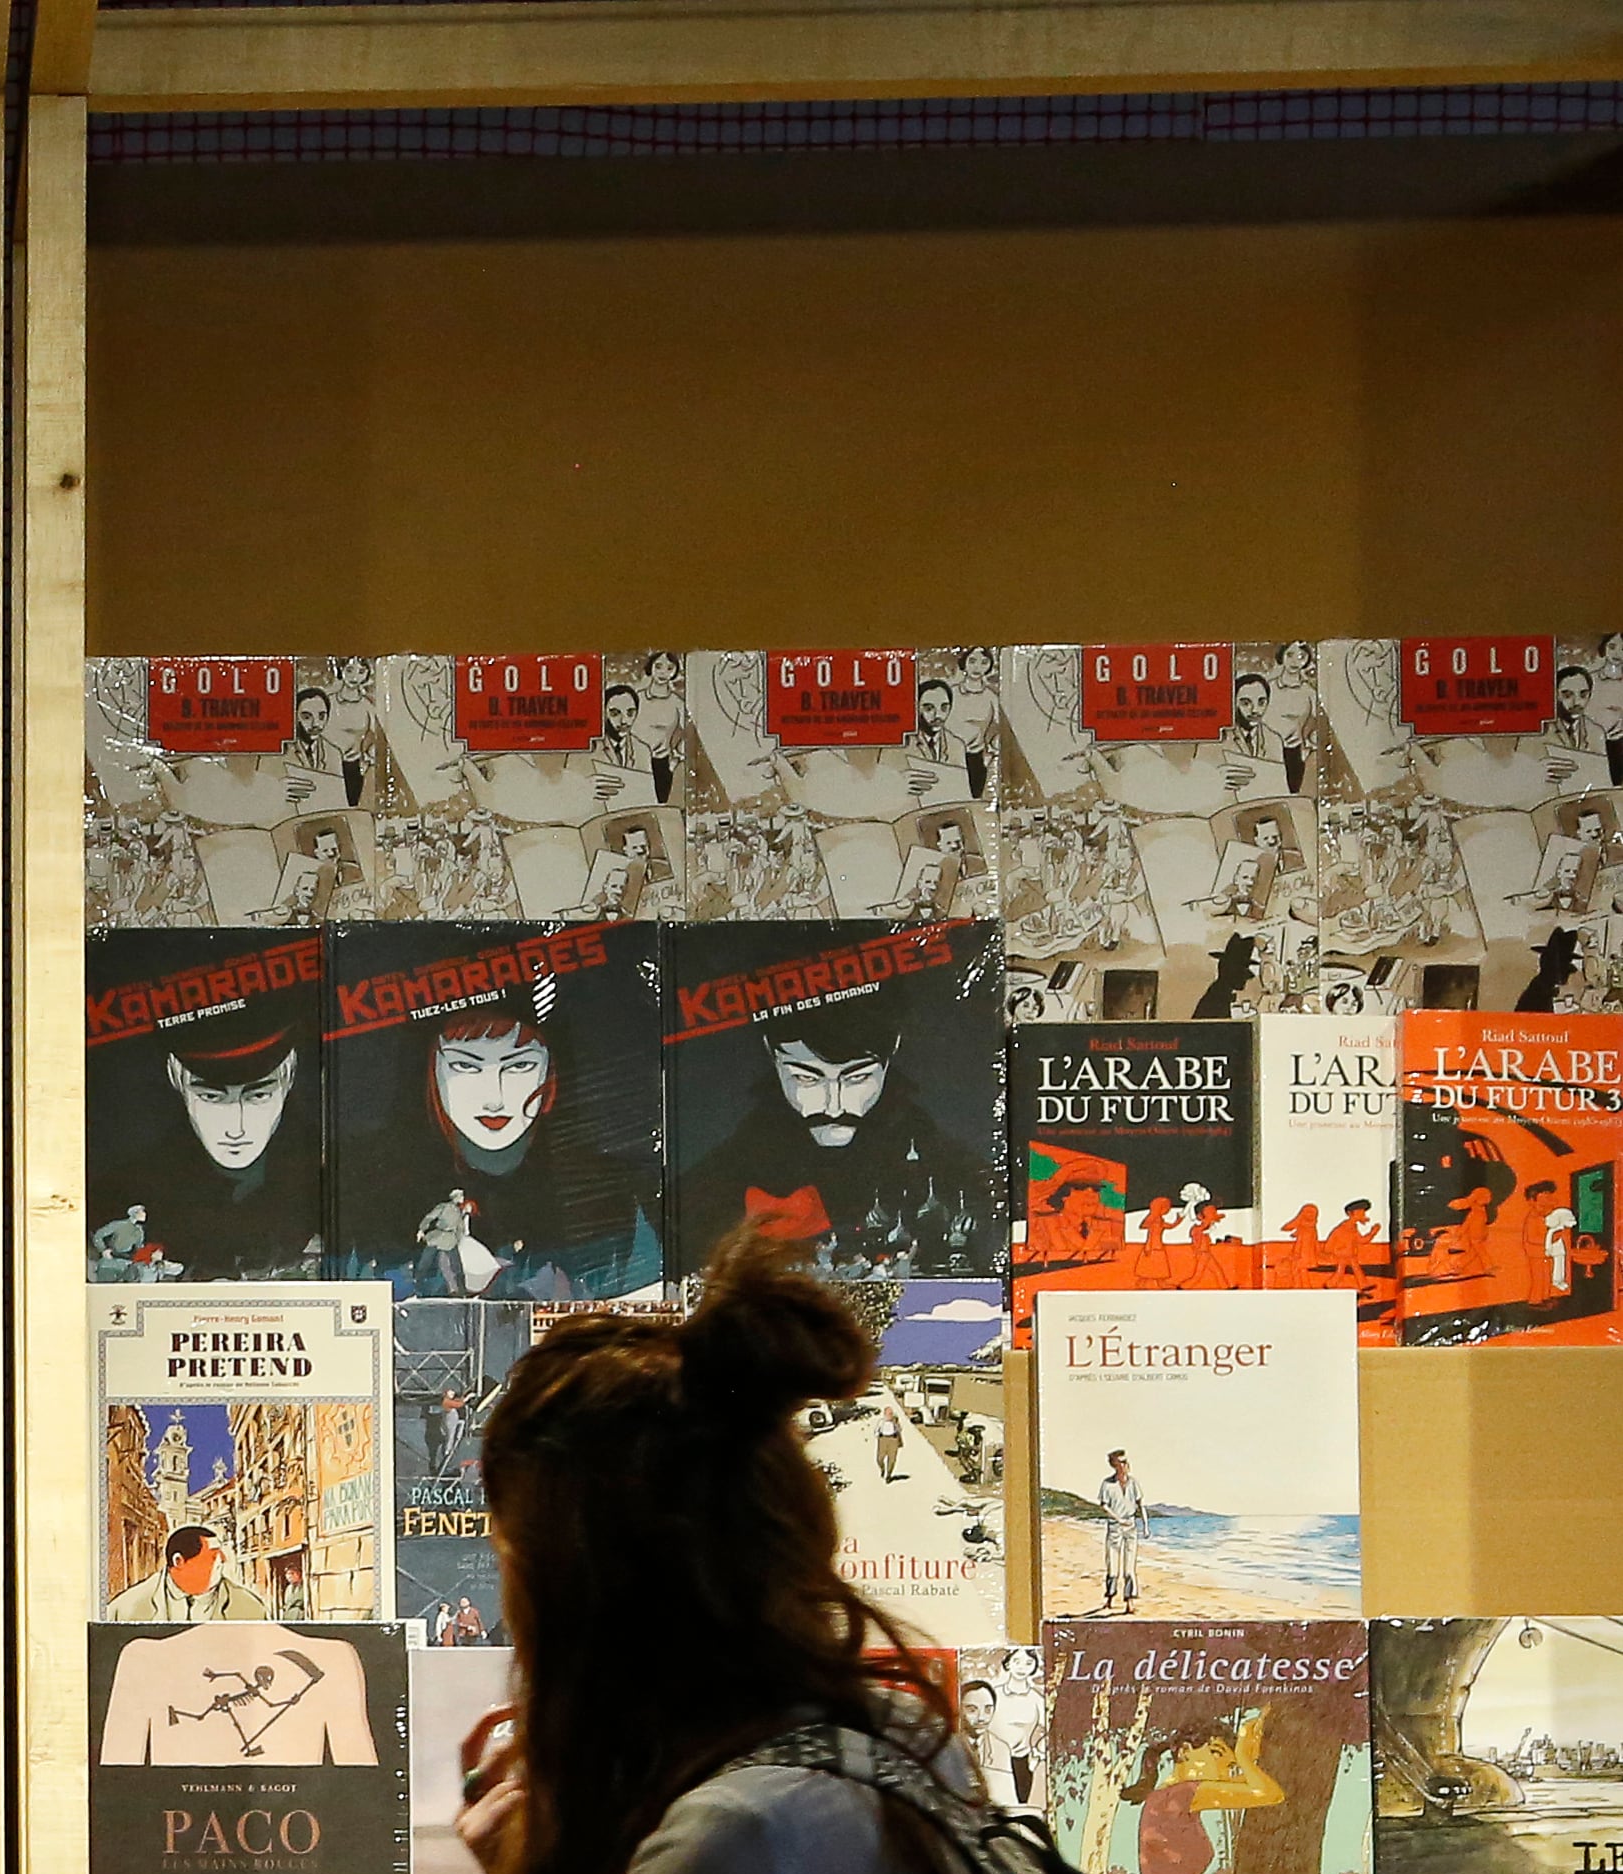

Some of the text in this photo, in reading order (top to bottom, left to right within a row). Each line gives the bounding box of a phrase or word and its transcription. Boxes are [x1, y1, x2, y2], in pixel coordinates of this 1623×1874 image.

[1481, 1028, 1568, 1044] Riad Sattouf
[1038, 1056, 1232, 1091] L'ARABE
[1433, 1046, 1621, 1082] L'ARABE
[1037, 1095, 1233, 1122] DU FUTUR
[1434, 1084, 1591, 1111] DU FUTUR
[171, 1333, 306, 1352] PEREIRA
[1066, 1327, 1272, 1374] L'Étranger
[168, 1358, 312, 1377] PRETEND
[411, 1488, 472, 1506] PASCAL
[1067, 1649, 1354, 1682] La délicatesse
[162, 1810, 321, 1854] PACO
